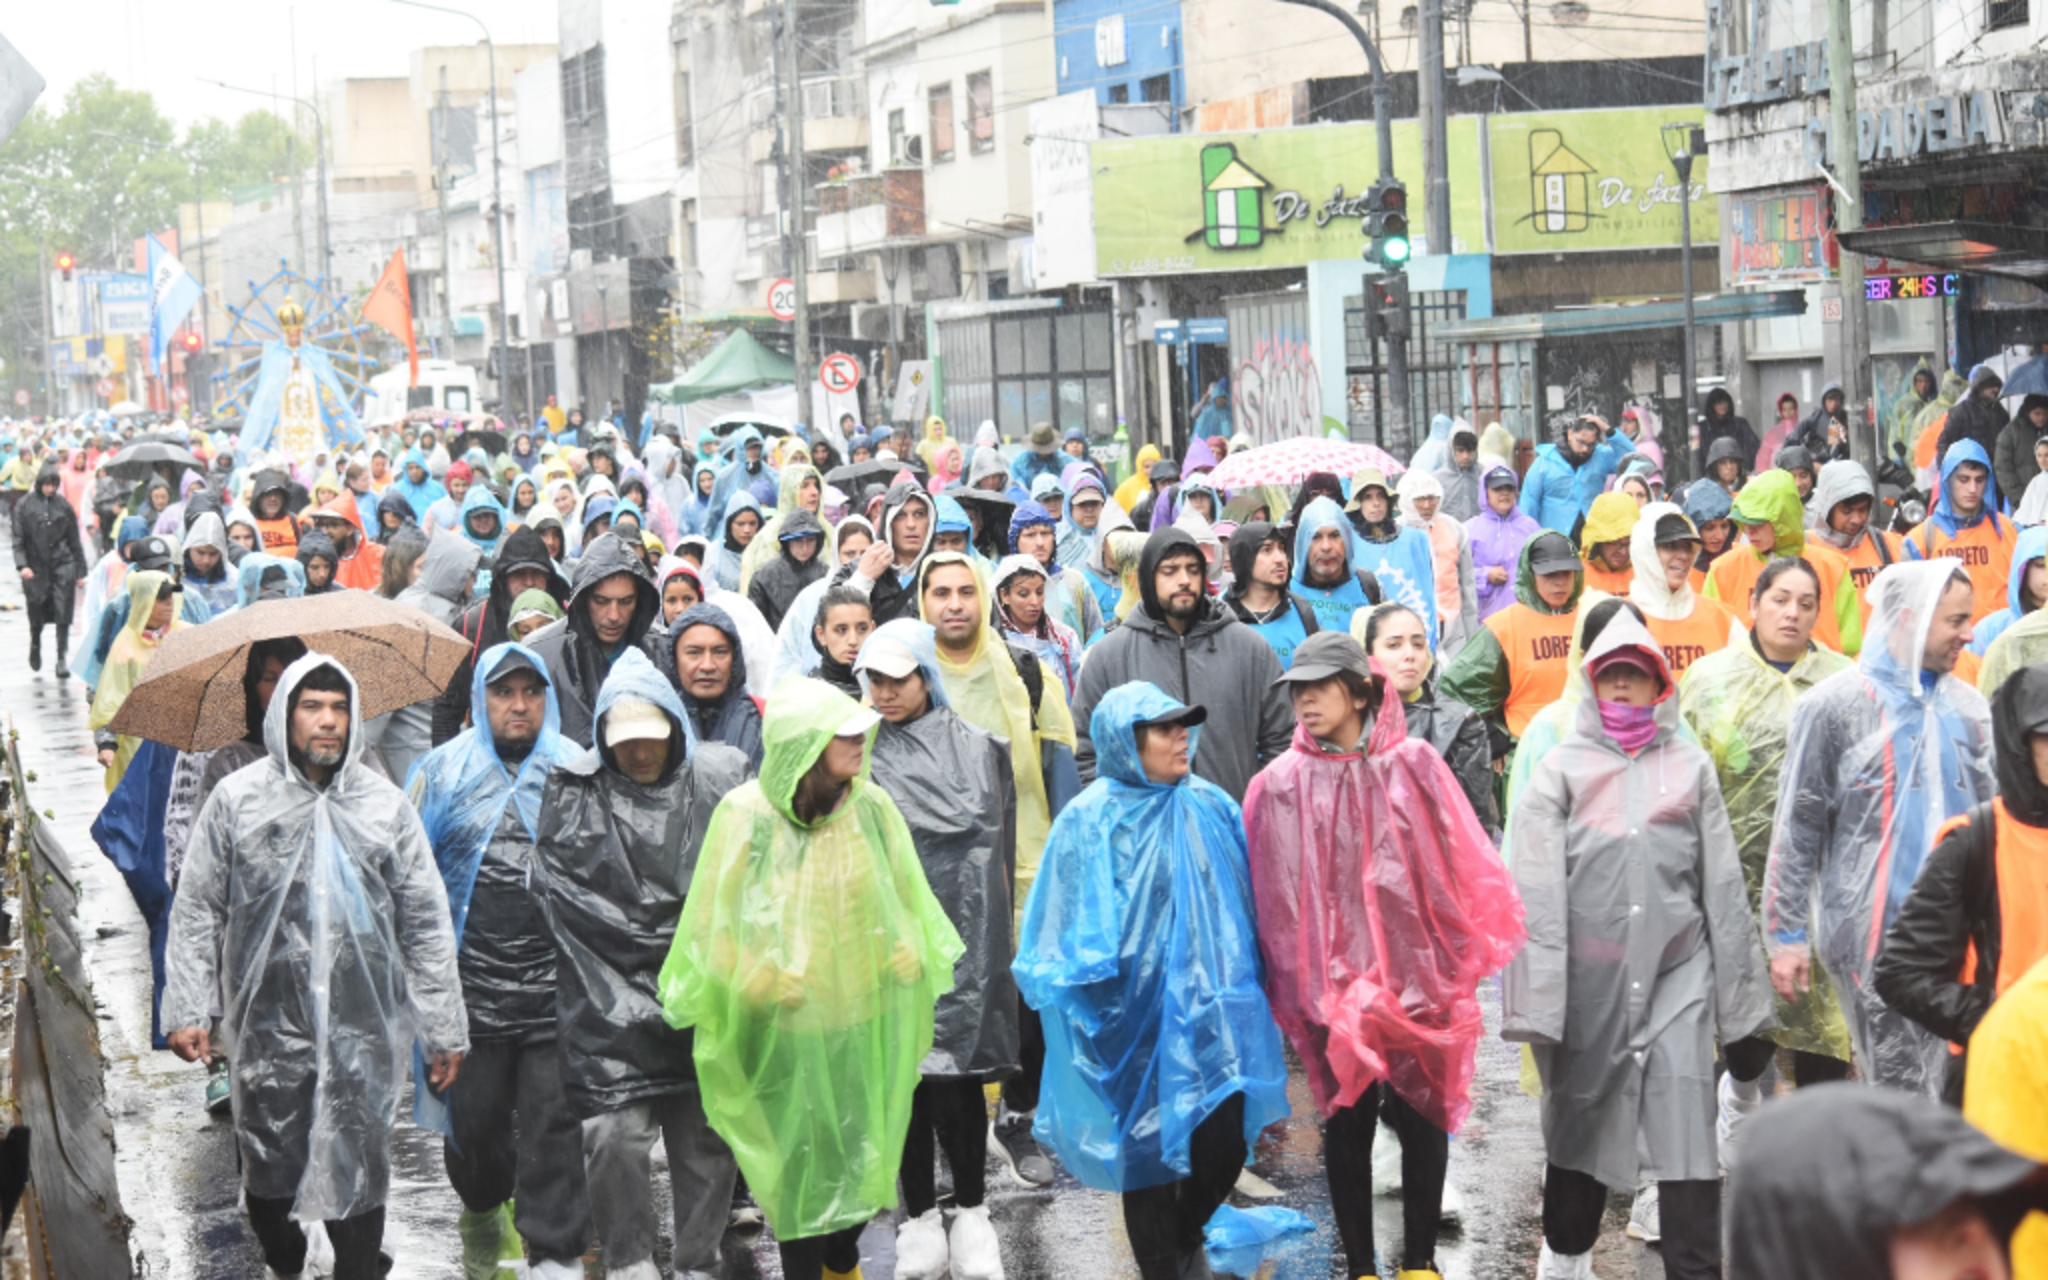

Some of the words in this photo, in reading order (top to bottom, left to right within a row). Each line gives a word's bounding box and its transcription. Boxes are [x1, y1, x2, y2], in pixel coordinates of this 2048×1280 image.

[1804, 89, 1998, 169] CIDADELA
[1597, 176, 1633, 210] De
[1272, 191, 1310, 225] De
[1595, 217, 1702, 231] INMOBILIAA
[1898, 275, 1937, 298] 24HS
[1531, 635, 1573, 661] LORE
[1663, 645, 1705, 671] RETO
